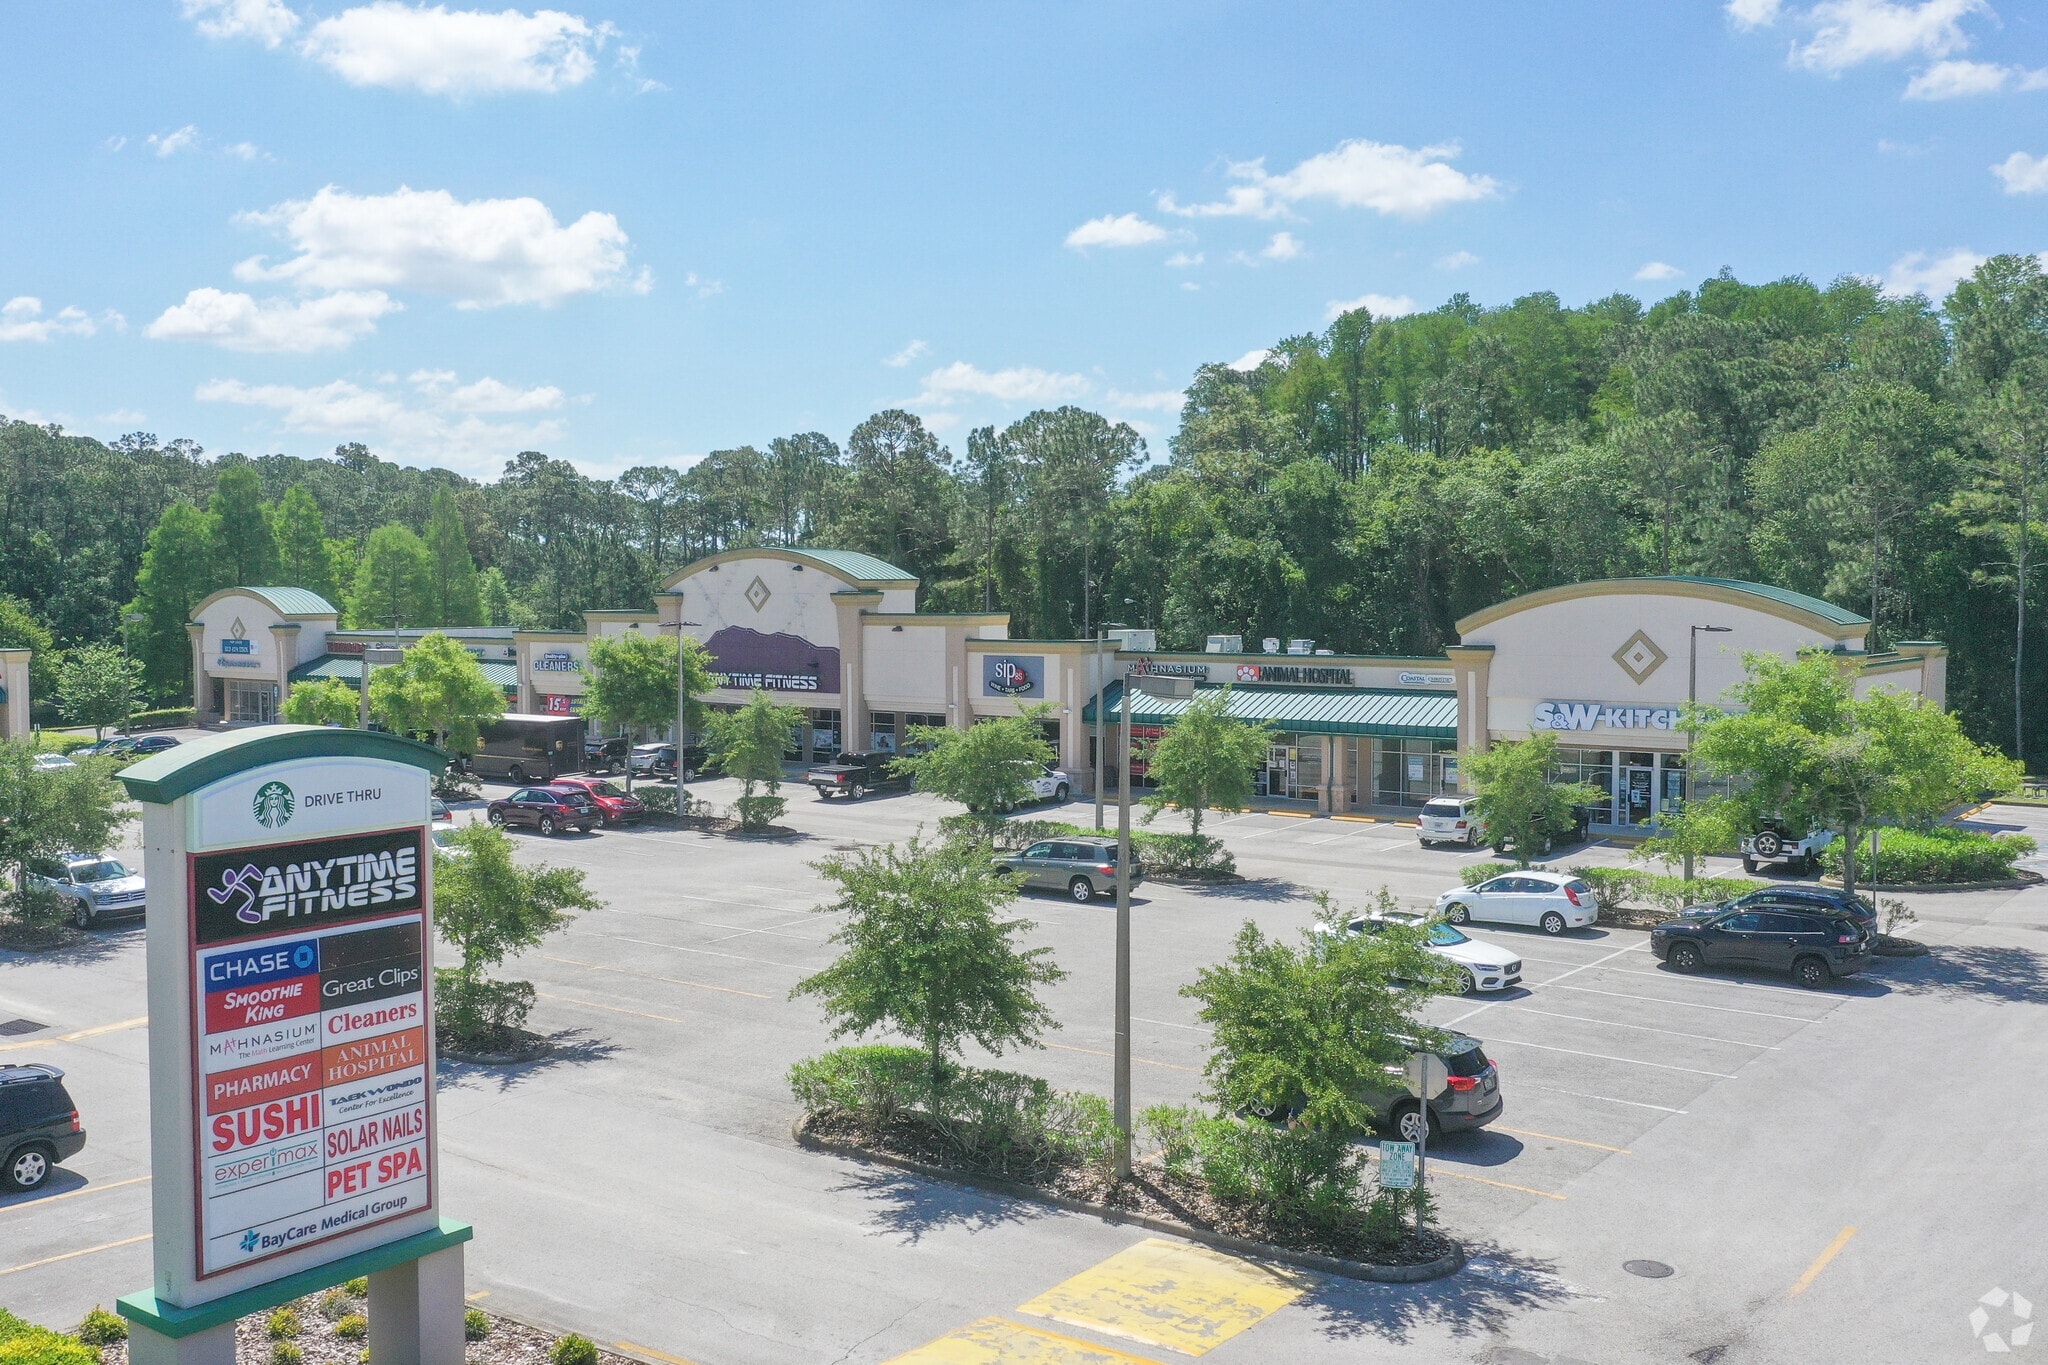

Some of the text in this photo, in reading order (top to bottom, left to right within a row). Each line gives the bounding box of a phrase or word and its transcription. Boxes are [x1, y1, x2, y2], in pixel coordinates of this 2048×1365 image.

[533, 660, 579, 672] CLEANERS
[995, 659, 1016, 686] sip
[1261, 666, 1353, 685] ANIMAL HOSPITAL
[765, 674, 818, 690] FITNESS
[1533, 702, 1601, 731] S&W
[305, 788, 382, 808] DRIVE THRU
[259, 846, 416, 897] ANYTIME
[262, 875, 416, 921] FITNESS
[210, 951, 290, 981] CHASE
[223, 983, 304, 1009] SMOOTHIE
[323, 968, 418, 997] Great Clips
[245, 1004, 285, 1024] KING
[328, 1003, 417, 1034] Cleaners
[239, 1050, 251, 1060] The
[269, 1041, 295, 1053] Learning
[295, 1037, 315, 1047] Center
[337, 1035, 411, 1063] ANIMAL
[329, 1049, 418, 1080] HOSPITAL
[214, 1063, 312, 1100] PHARMACY
[338, 1090, 414, 1114] Center For Excellence
[212, 1094, 320, 1152] SUSHI
[327, 1108, 422, 1158] SOLAR NAILS
[214, 1144, 318, 1181] experimax
[1382, 1143, 1413, 1153] TOW AWAY
[1389, 1152, 1405, 1161] ZONE
[328, 1161, 372, 1198] PET
[378, 1147, 422, 1183] SPA
[261, 1196, 408, 1249] BayCare Medical Group
